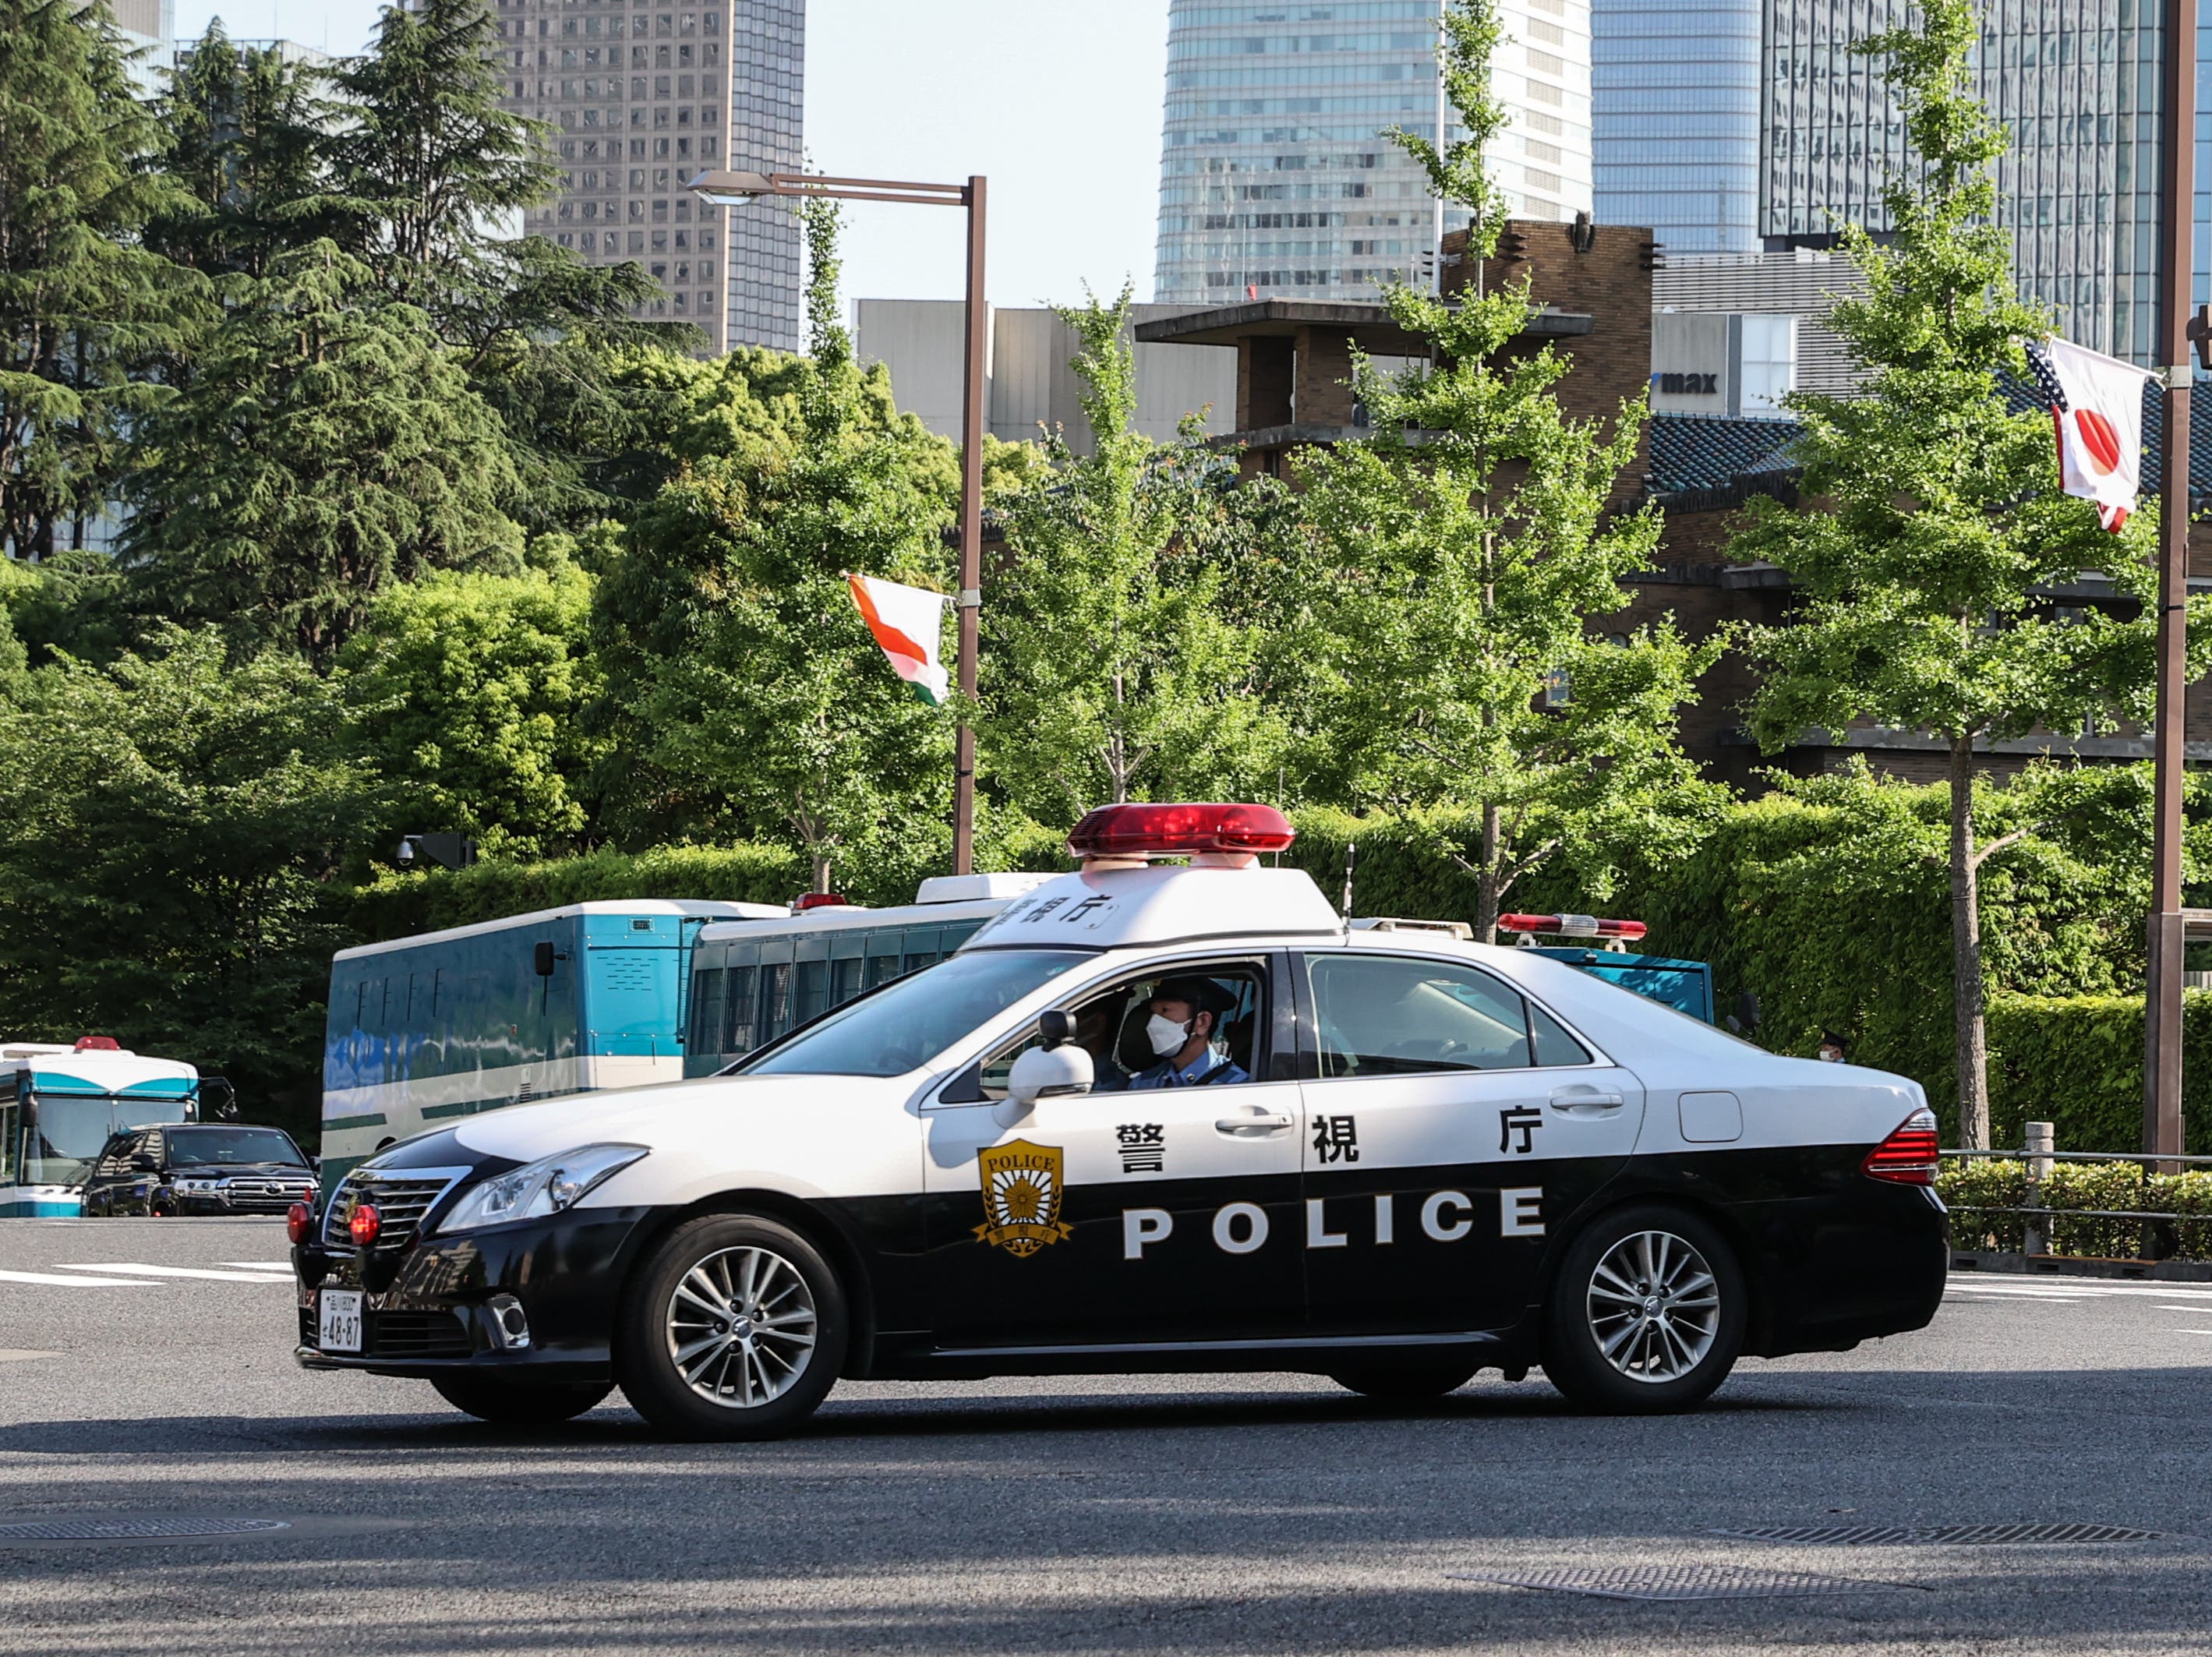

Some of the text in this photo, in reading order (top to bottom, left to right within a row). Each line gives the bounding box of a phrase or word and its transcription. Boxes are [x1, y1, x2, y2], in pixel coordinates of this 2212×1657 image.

[987, 1154, 1055, 1171] POLICE
[1116, 1104, 1543, 1174] 警視庁
[1122, 1185, 1546, 1261] POLICE
